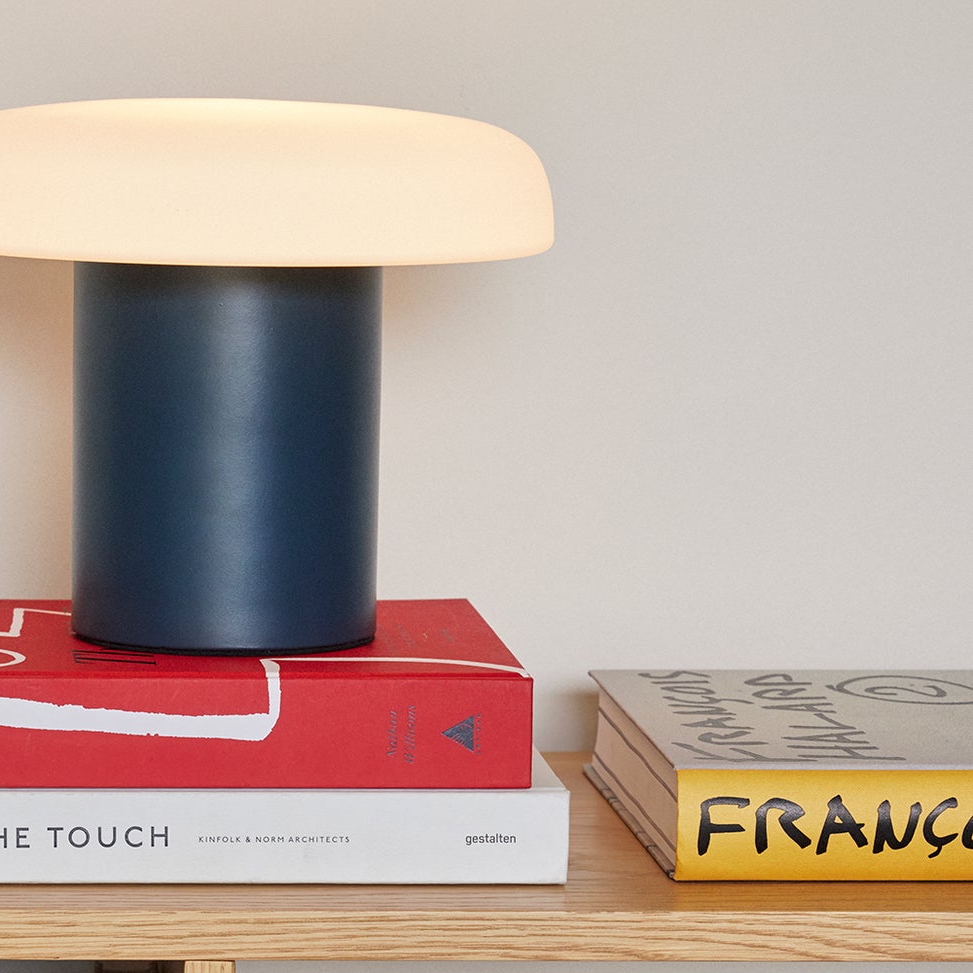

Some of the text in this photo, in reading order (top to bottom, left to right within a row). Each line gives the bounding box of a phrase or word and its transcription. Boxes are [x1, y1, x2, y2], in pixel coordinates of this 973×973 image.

[638, 670, 818, 762] FRANÇOIS
[744, 673, 906, 761] HALARD
[47, 825, 169, 849] TOUCH
[465, 833, 517, 846] gestalten
